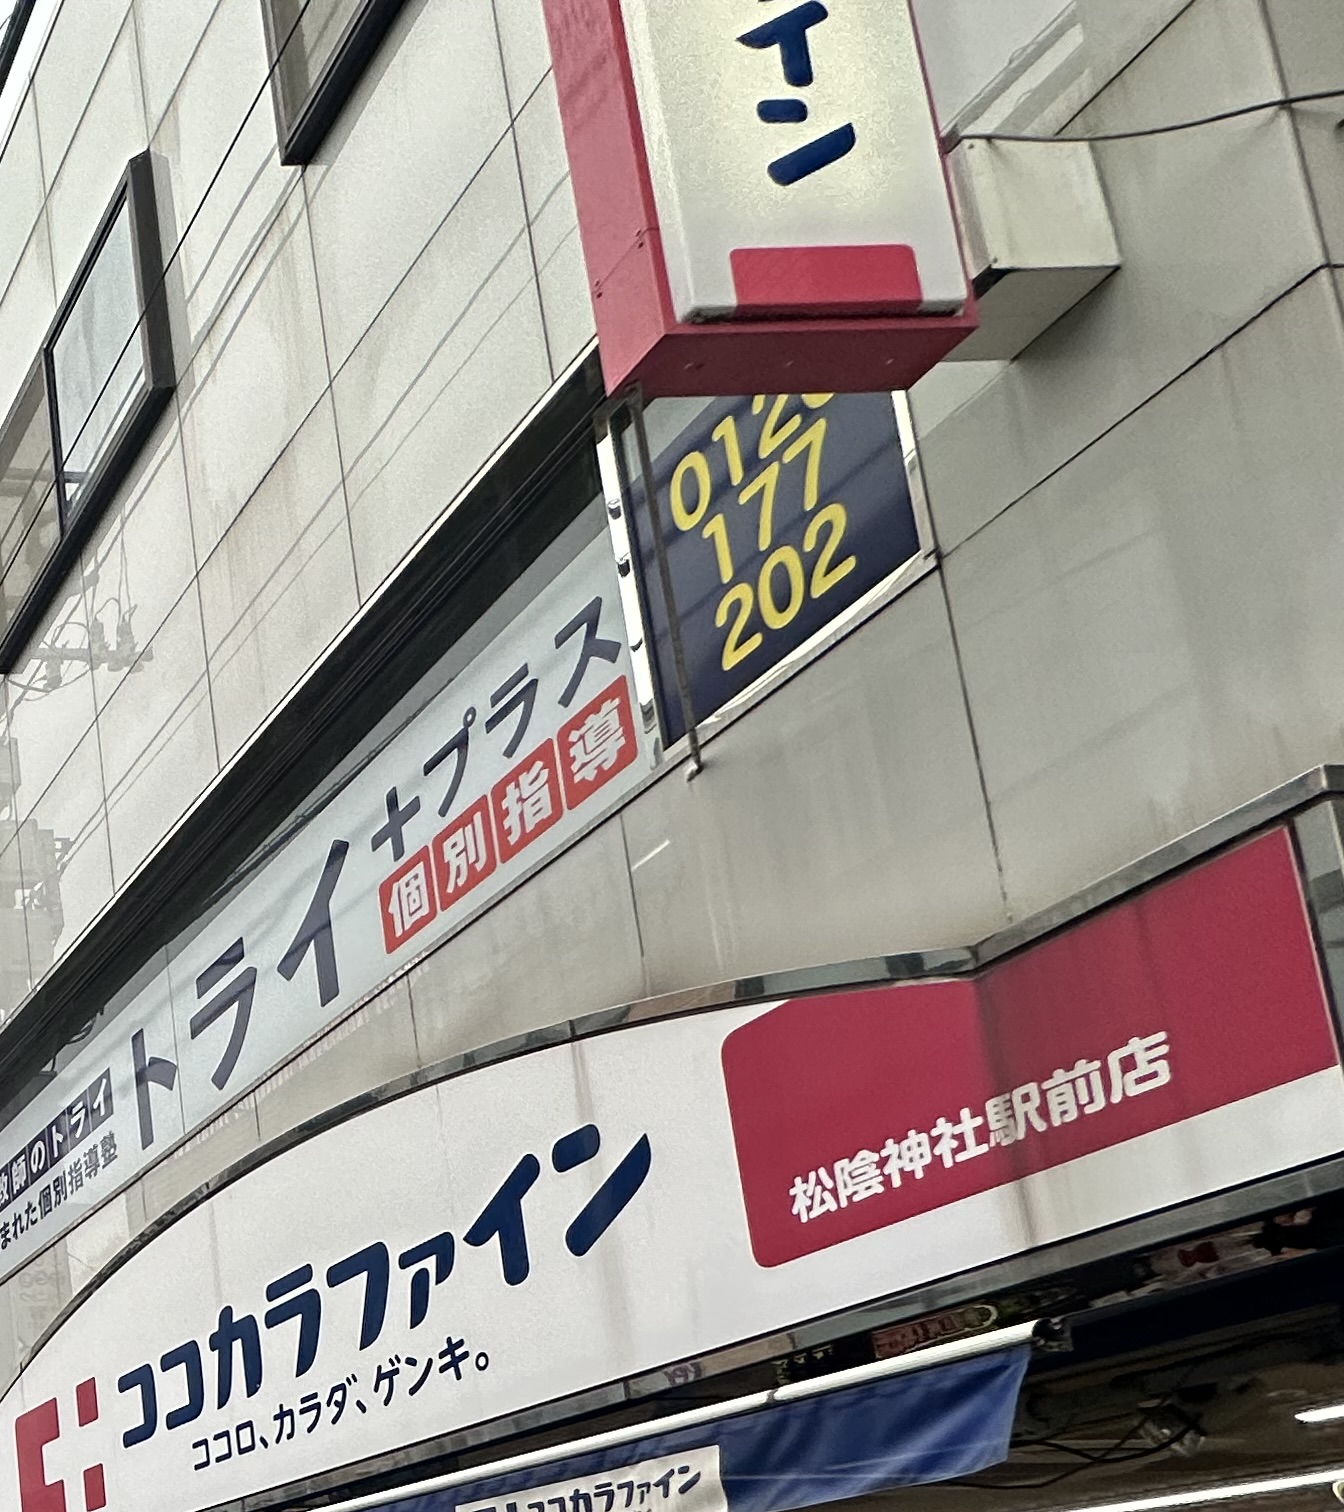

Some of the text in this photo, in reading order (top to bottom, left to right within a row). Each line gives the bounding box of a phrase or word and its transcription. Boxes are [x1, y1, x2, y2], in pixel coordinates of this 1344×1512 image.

[669, 393, 835, 533] 012
[702, 417, 827, 585] 177
[715, 503, 857, 671] 202
[388, 697, 627, 938] 個別指導
[131, 840, 350, 1150] トライ
[789, 1031, 1172, 1223] 松陰神社駅前店
[117, 1123, 652, 1448] ココカラファイン
[191, 1336, 489, 1471] ココロ、カラダ、ゲンキ。
